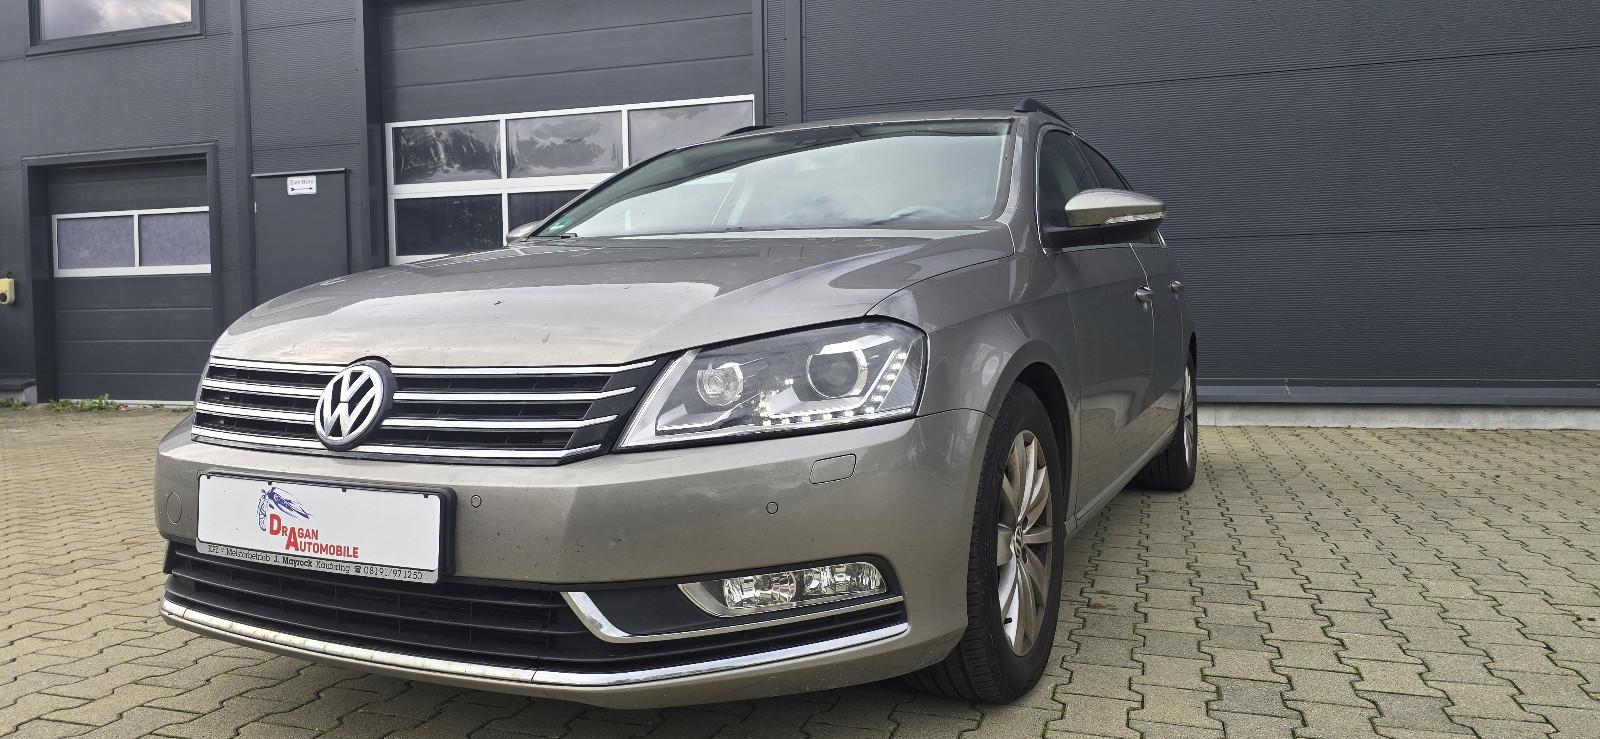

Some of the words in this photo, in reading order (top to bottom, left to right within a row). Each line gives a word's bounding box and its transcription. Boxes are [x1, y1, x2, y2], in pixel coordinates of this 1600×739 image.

[316, 367, 381, 442] VW
[285, 527, 359, 559] AUTOMOBILE
[273, 555, 280, 564] J.
[282, 556, 313, 568] Mayrock
